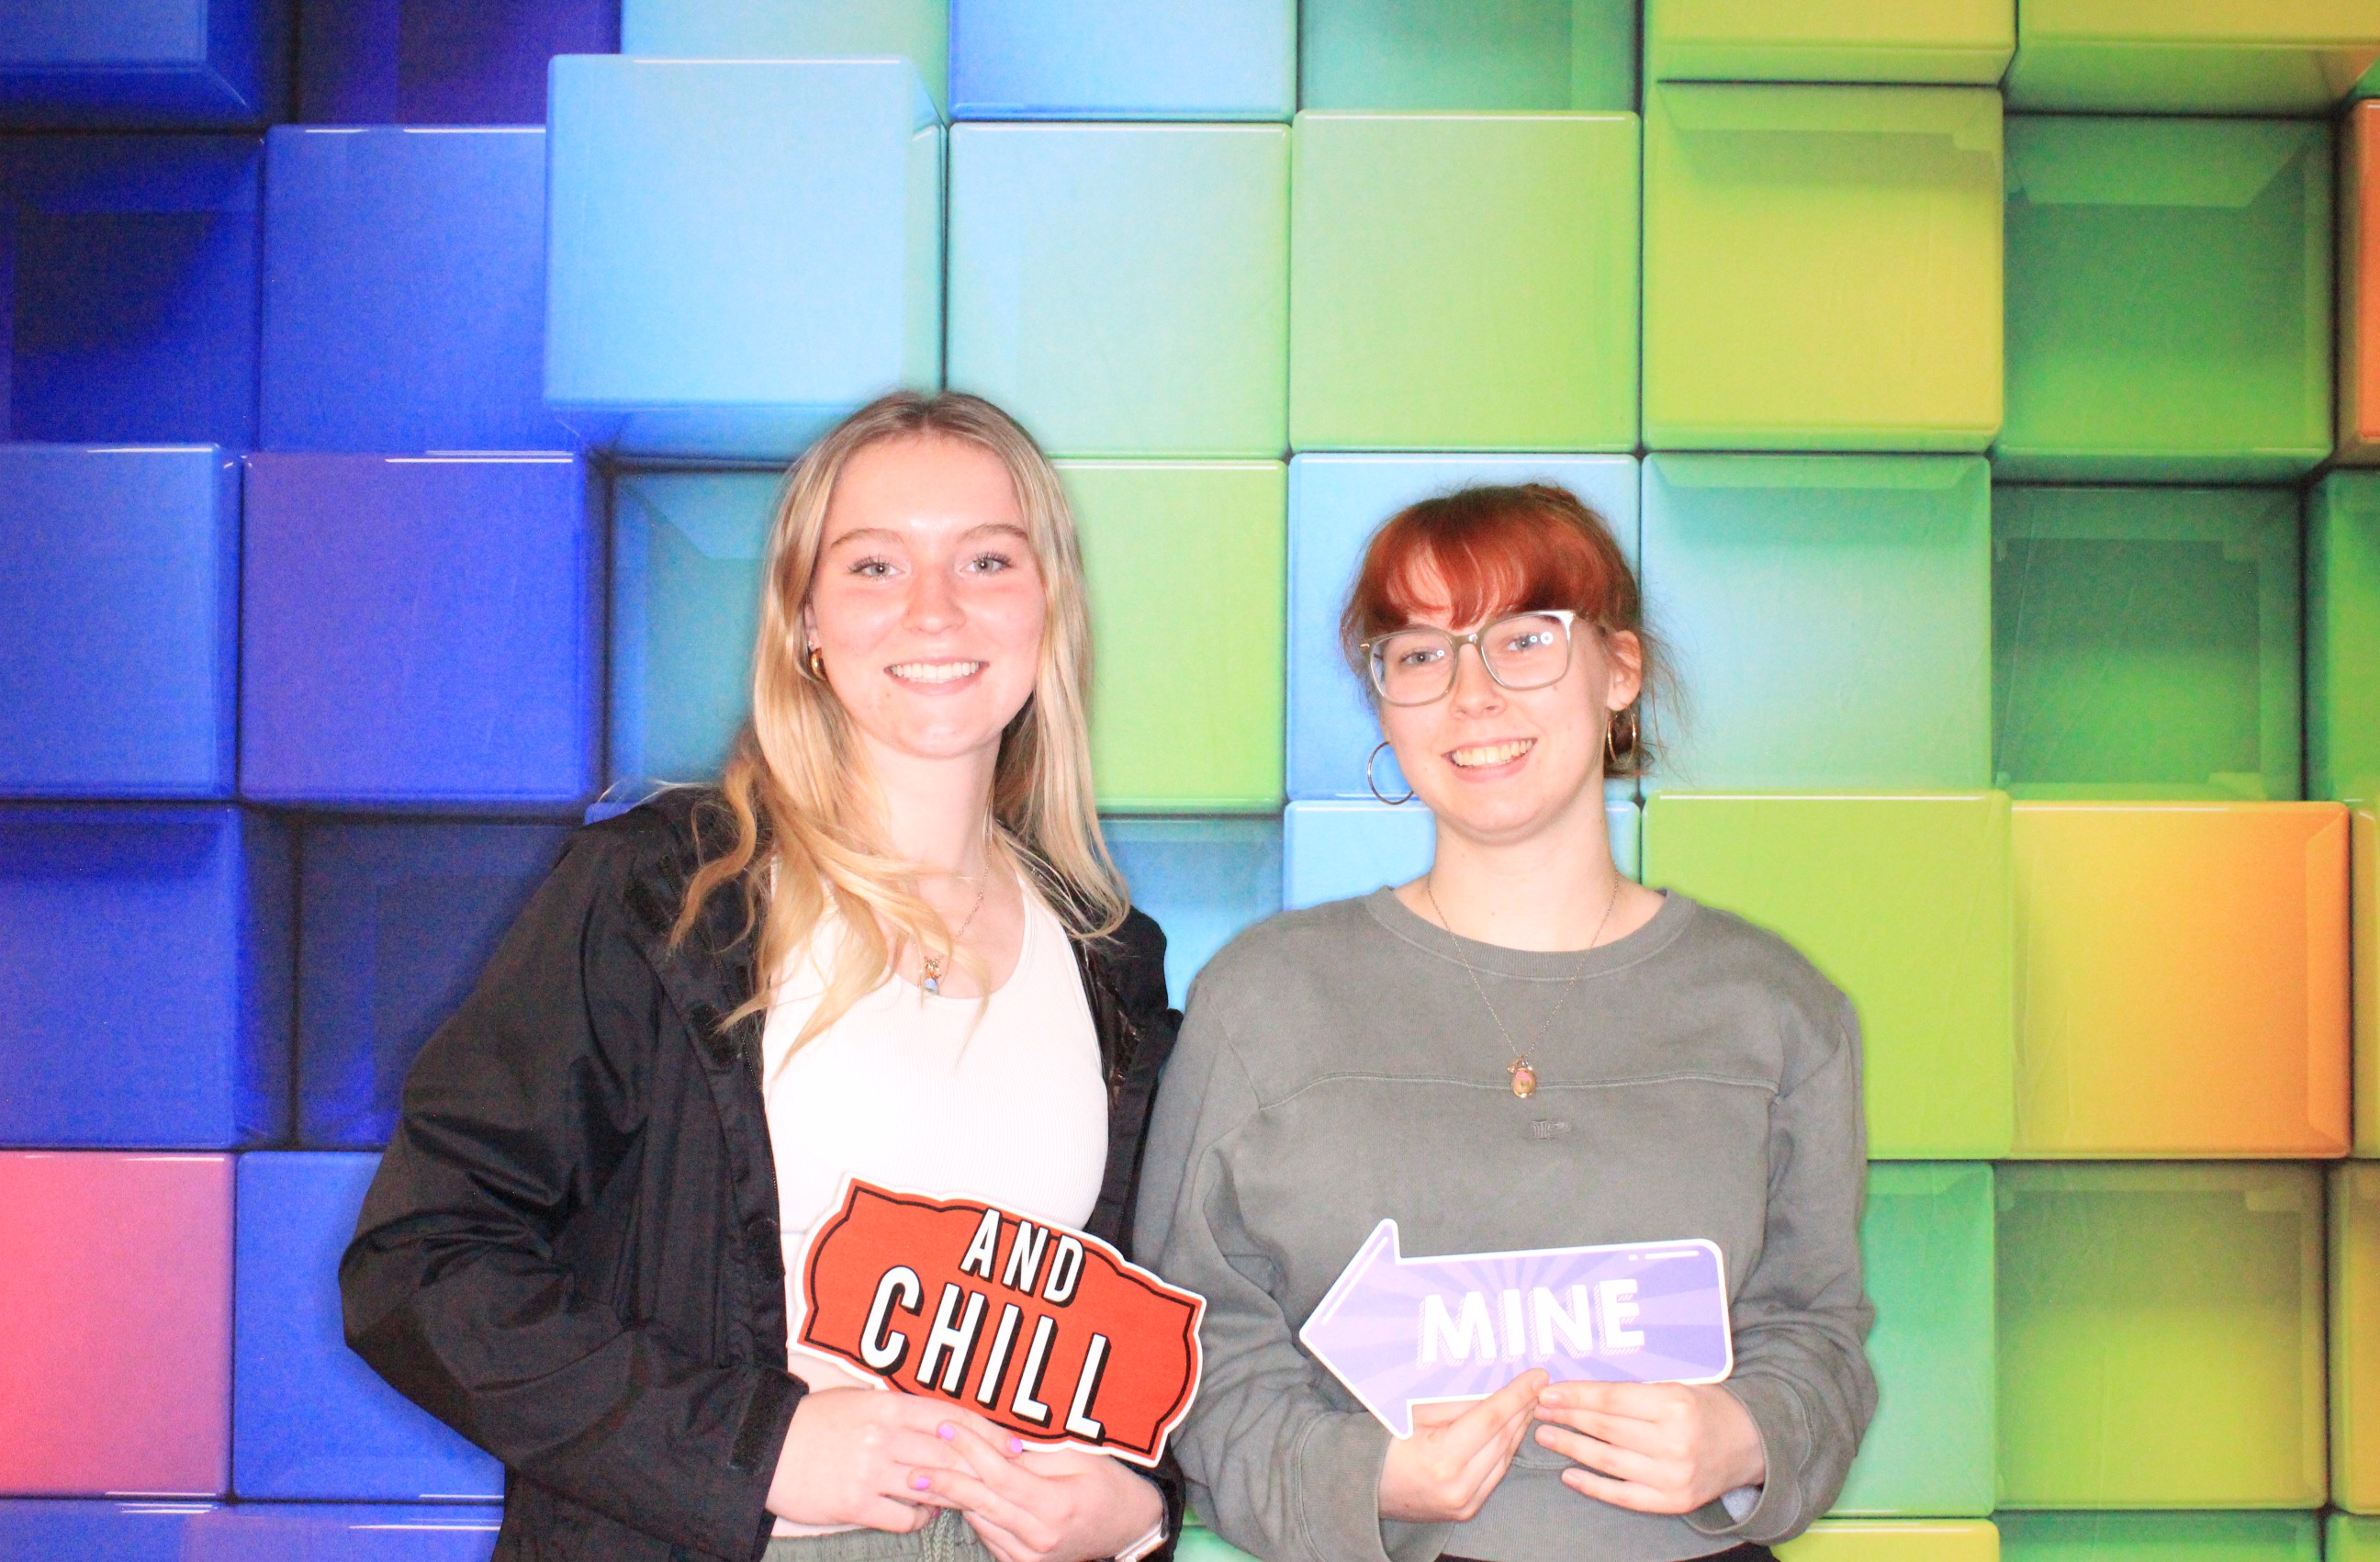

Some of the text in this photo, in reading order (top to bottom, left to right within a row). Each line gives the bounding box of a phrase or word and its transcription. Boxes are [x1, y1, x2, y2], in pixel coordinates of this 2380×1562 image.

[960, 1208, 1086, 1308] AND
[859, 1264, 1111, 1444] CHILL
[1417, 1279, 1645, 1367] MINE
